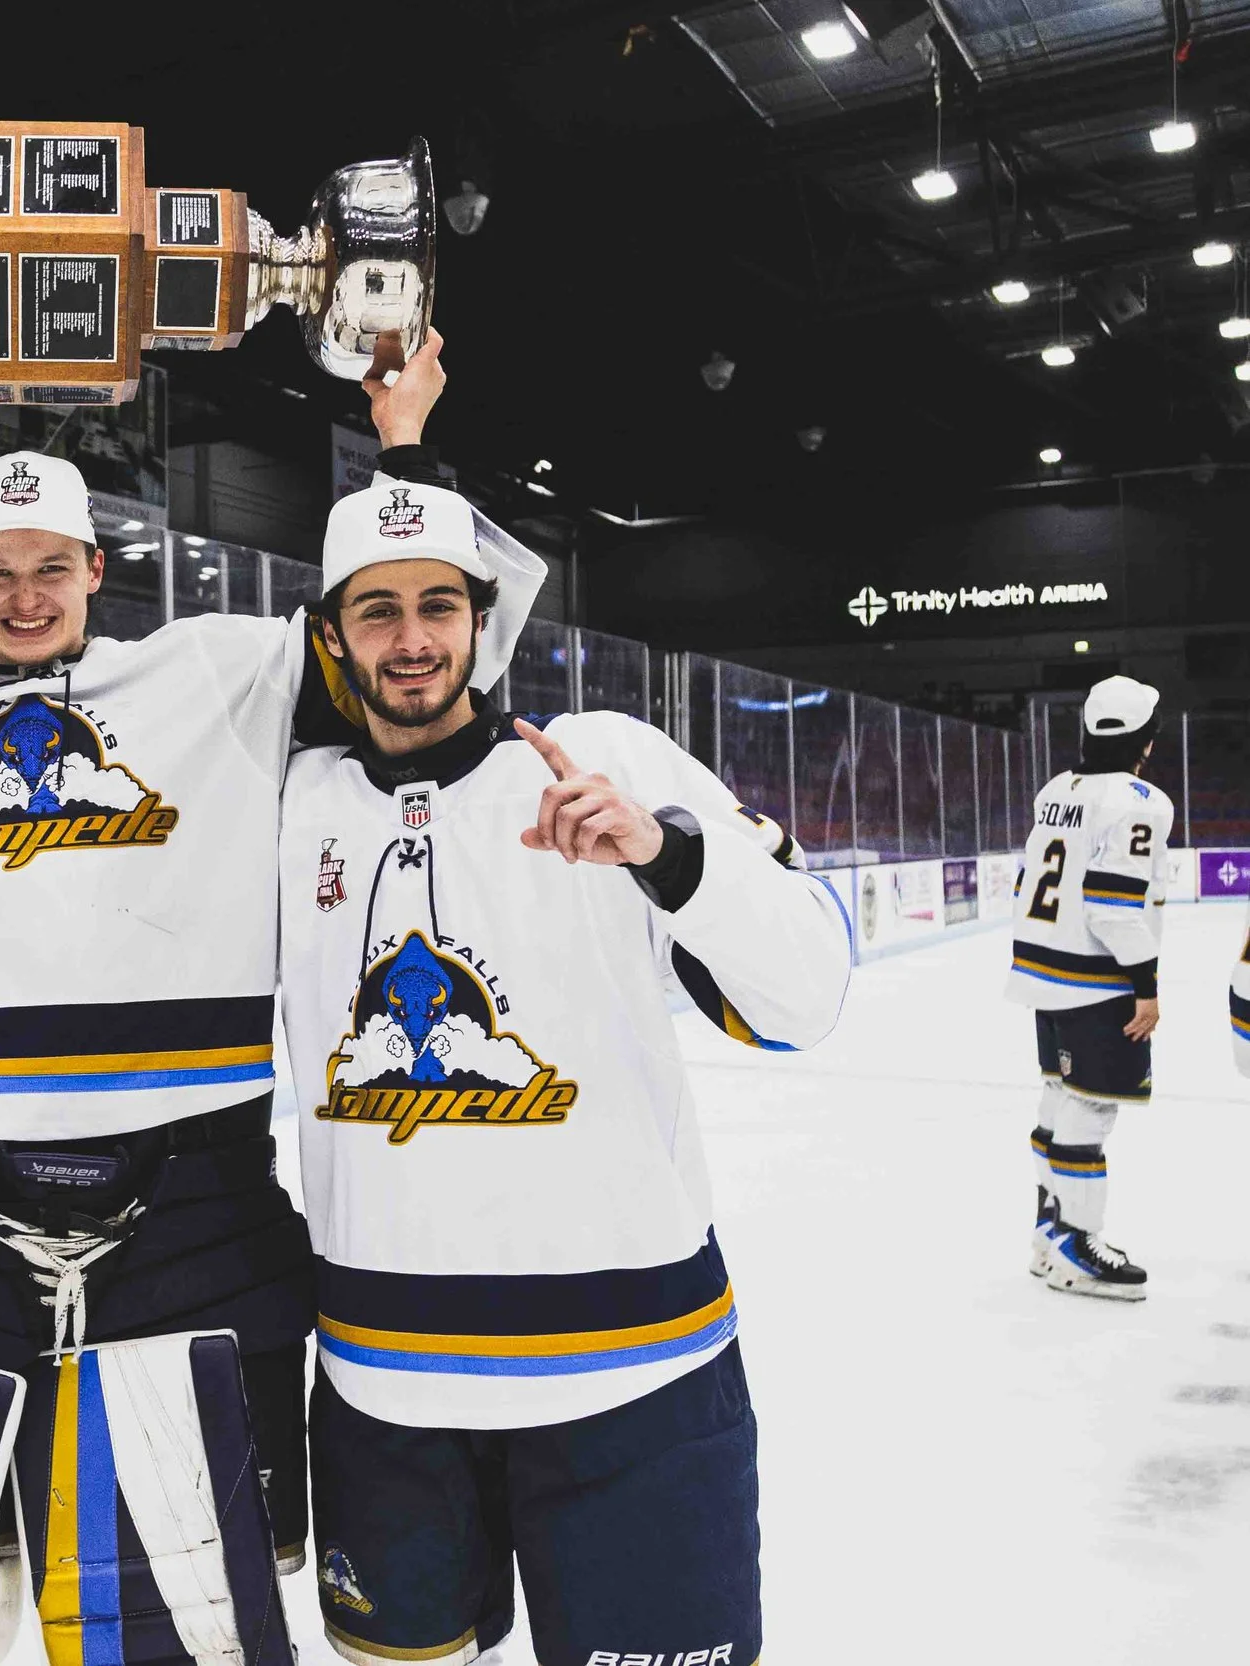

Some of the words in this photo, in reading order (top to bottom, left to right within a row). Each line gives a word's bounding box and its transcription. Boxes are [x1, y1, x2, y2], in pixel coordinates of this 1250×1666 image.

[2, 476, 38, 487] CLARK
[8, 484, 31, 492] CUP
[2, 491, 38, 500] CHAMPIONS
[380, 506, 421, 517] CLARK
[388, 515, 414, 524] CUP
[381, 522, 423, 533] CHAMPIONS
[891, 589, 957, 614] Trinity
[960, 584, 1034, 608] Health
[1040, 582, 1108, 604] ARENA
[52, 698, 118, 750] ALLS
[405, 803, 428, 813] USHL
[1129, 823, 1152, 857] 2
[1027, 838, 1067, 923] 2
[437, 934, 511, 1015] FALLS
